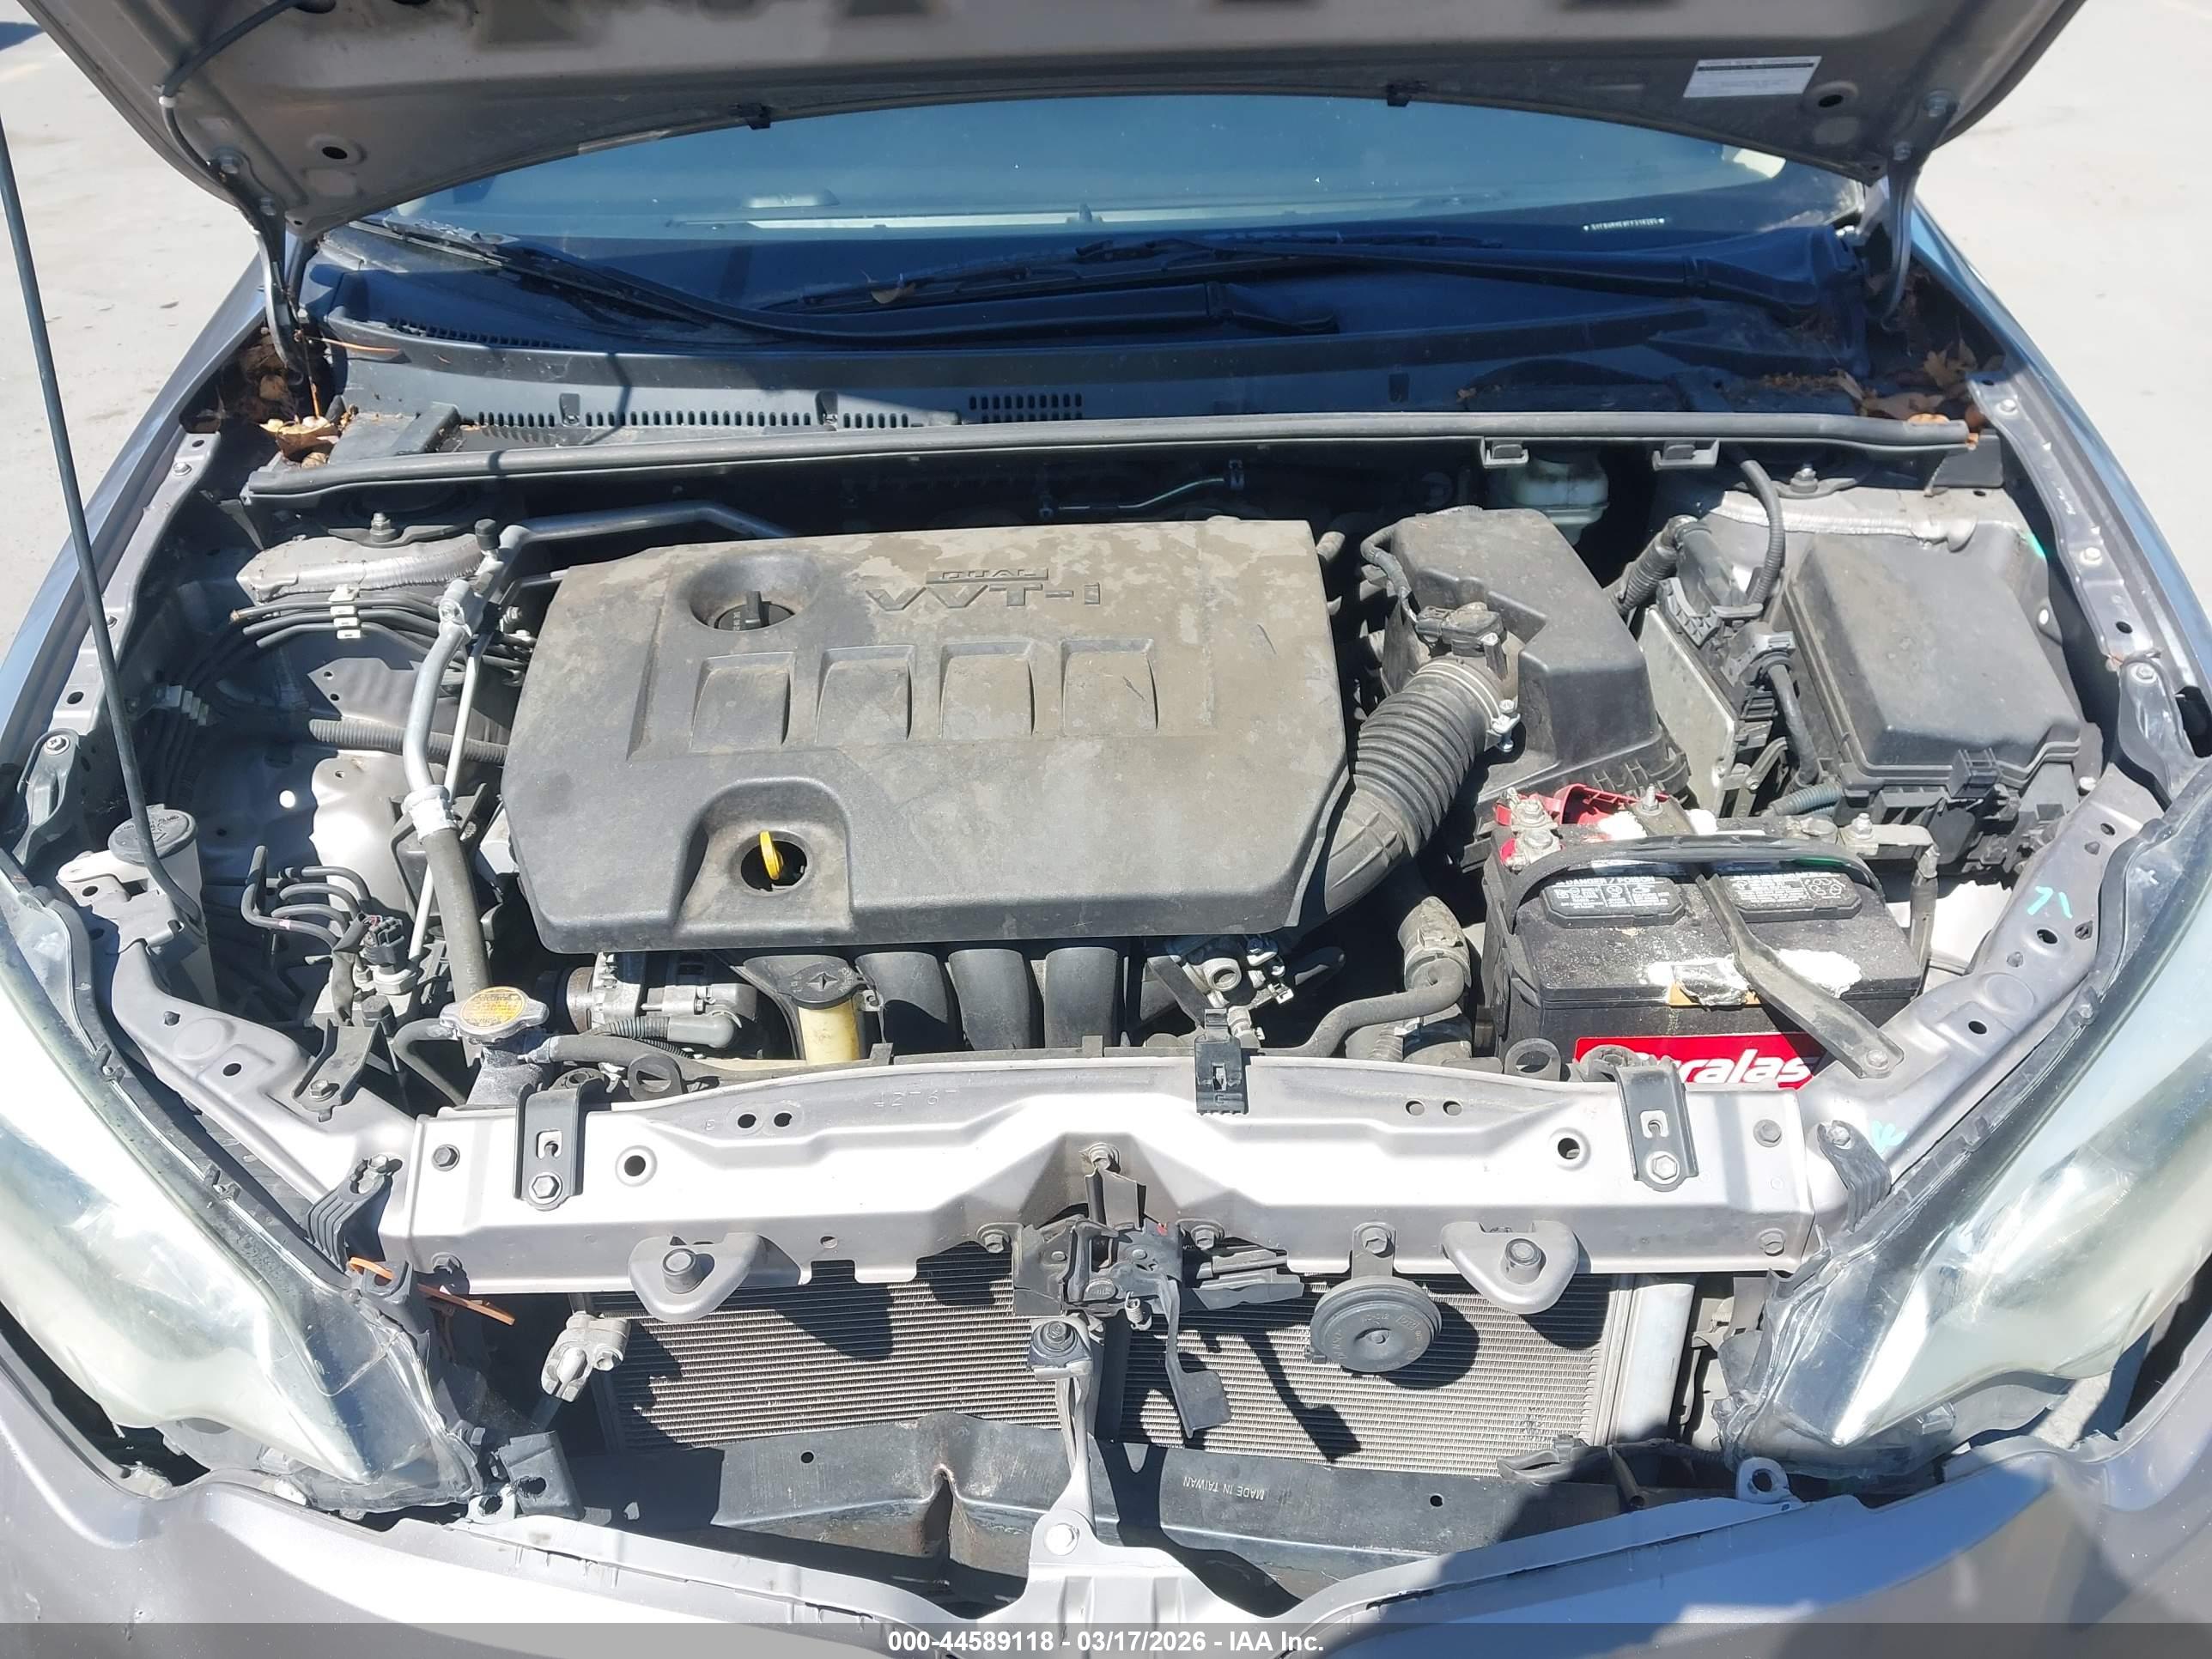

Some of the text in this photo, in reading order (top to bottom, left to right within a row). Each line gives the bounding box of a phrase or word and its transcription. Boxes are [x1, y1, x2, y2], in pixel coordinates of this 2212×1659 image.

[1673, 1048, 1818, 1083] ralas
[1182, 1476, 1265, 1500] MADE IN TAIWAN
